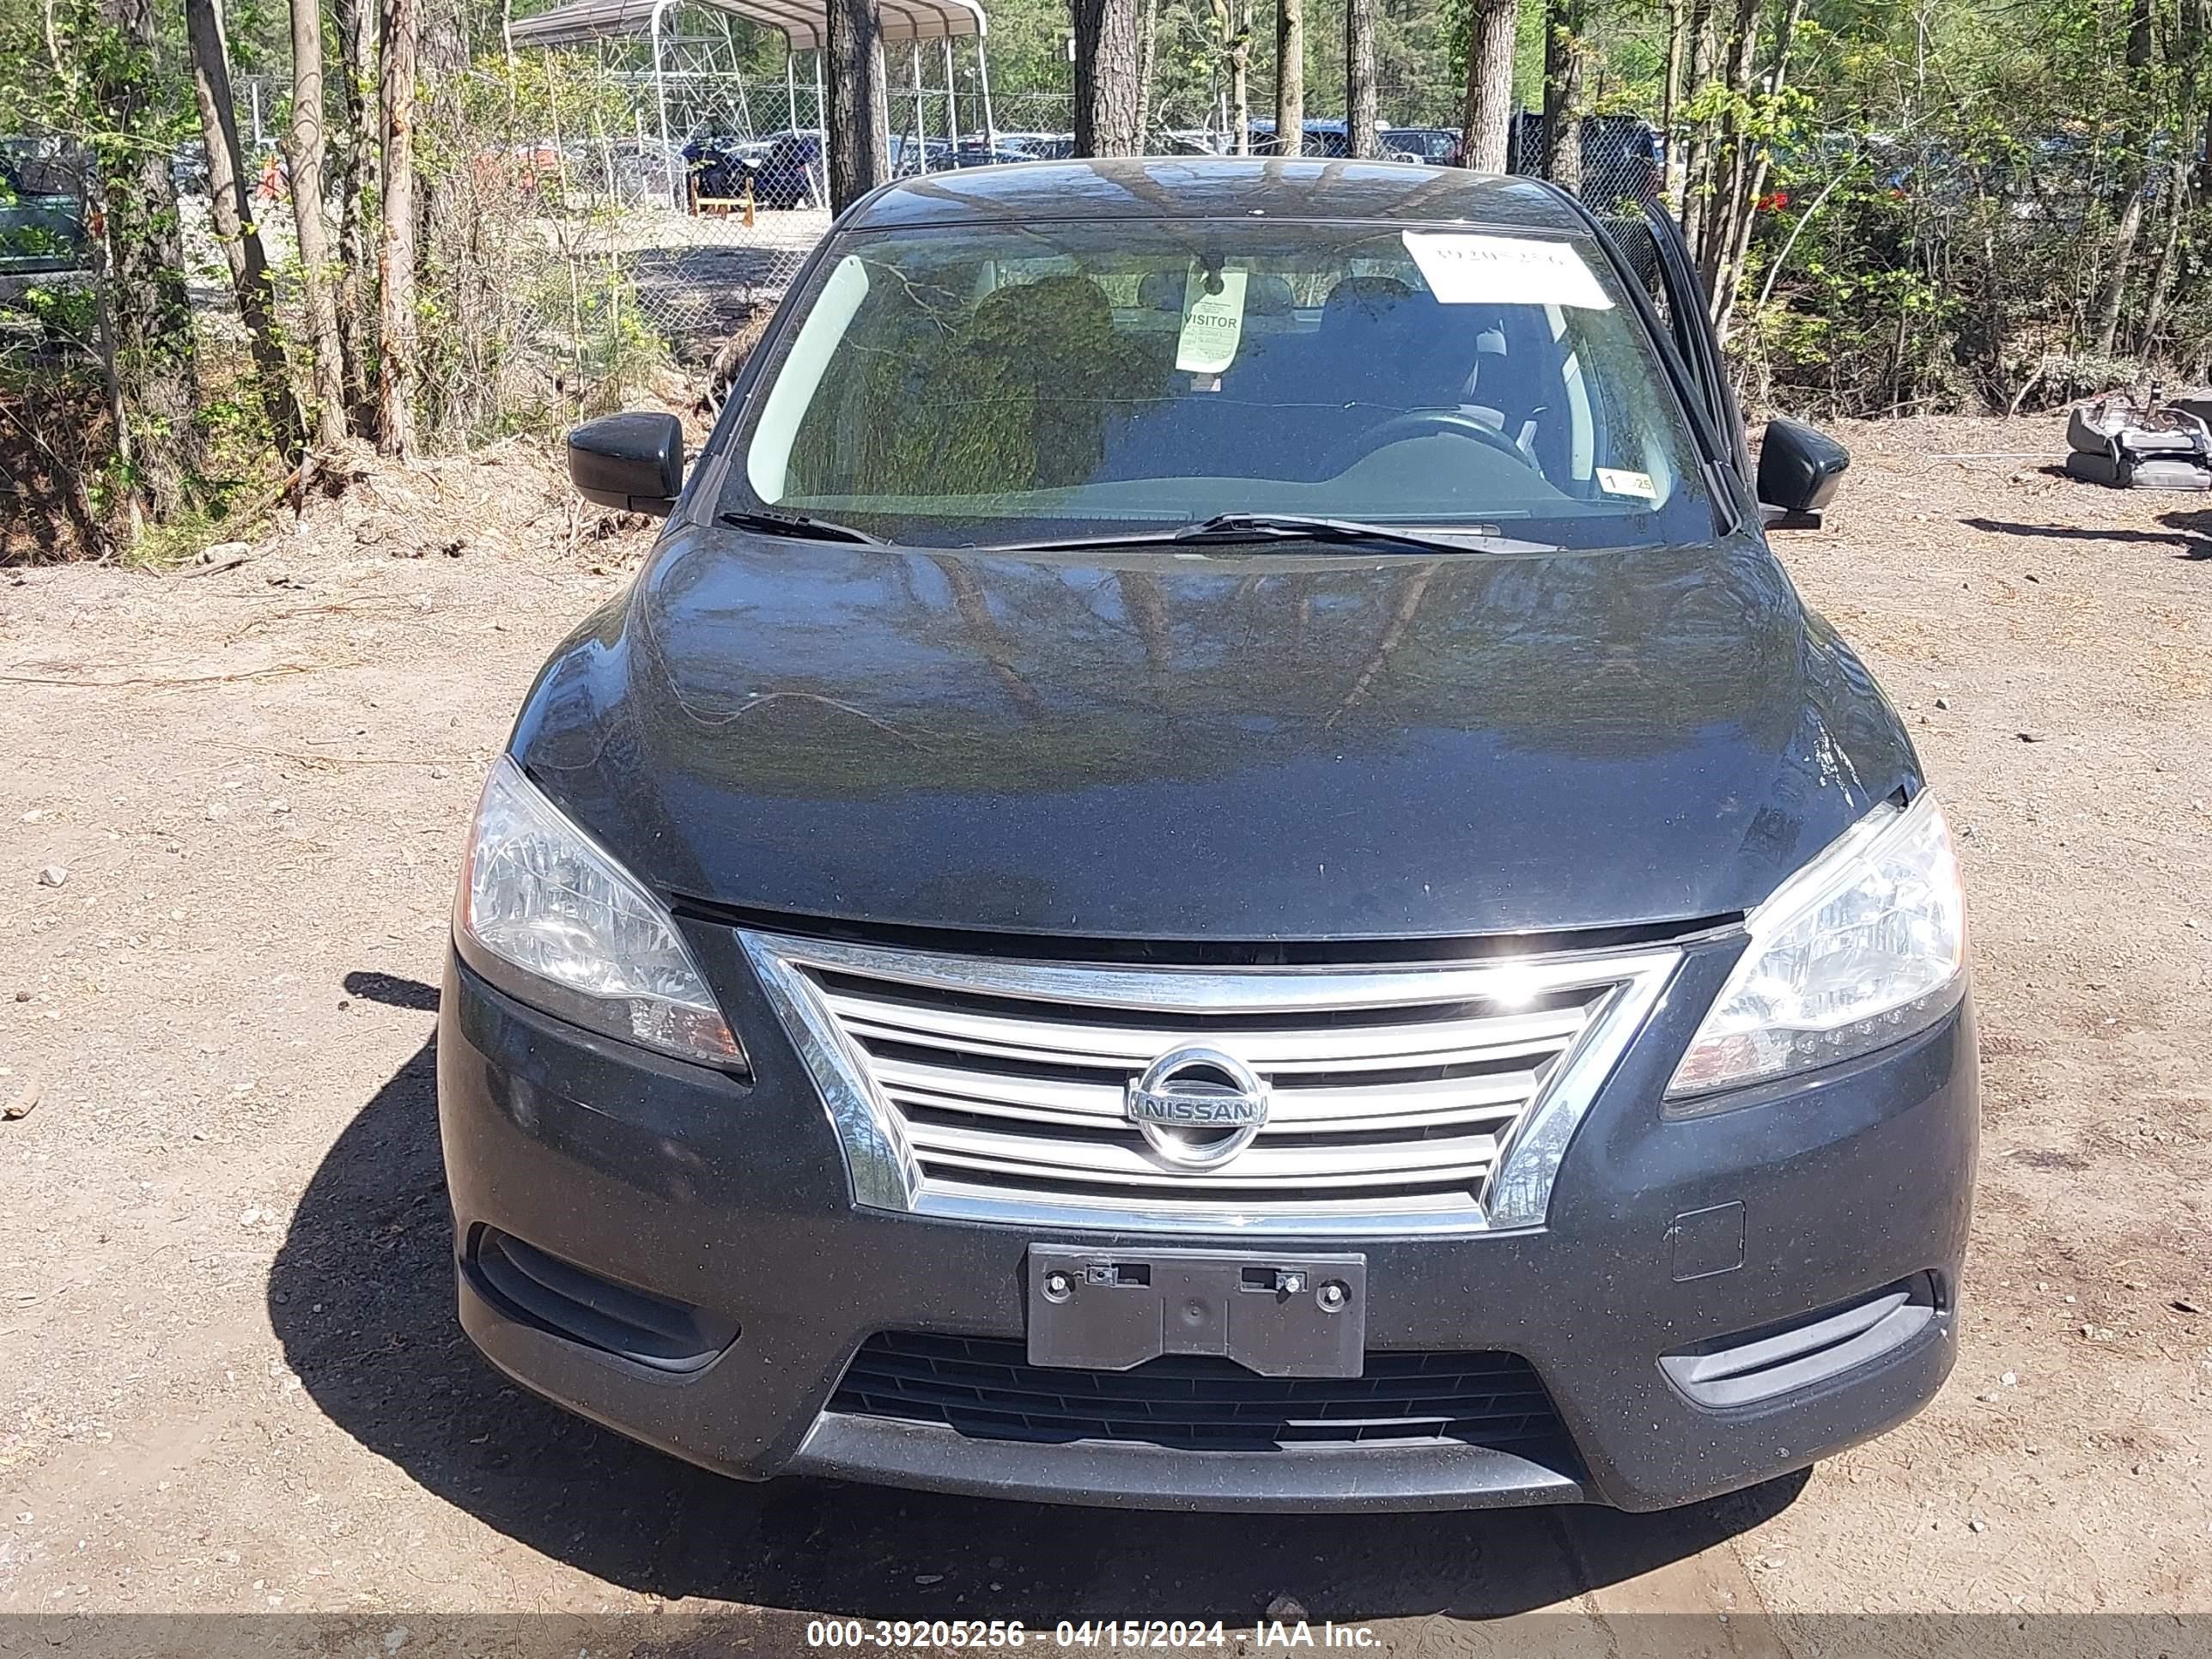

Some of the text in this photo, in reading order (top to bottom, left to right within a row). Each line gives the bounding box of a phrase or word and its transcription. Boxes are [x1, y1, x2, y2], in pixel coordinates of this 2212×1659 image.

[1184, 313, 1237, 329] VISITOR
[1636, 478, 1652, 489] 25
[1145, 1099, 1253, 1121] NISSAN
